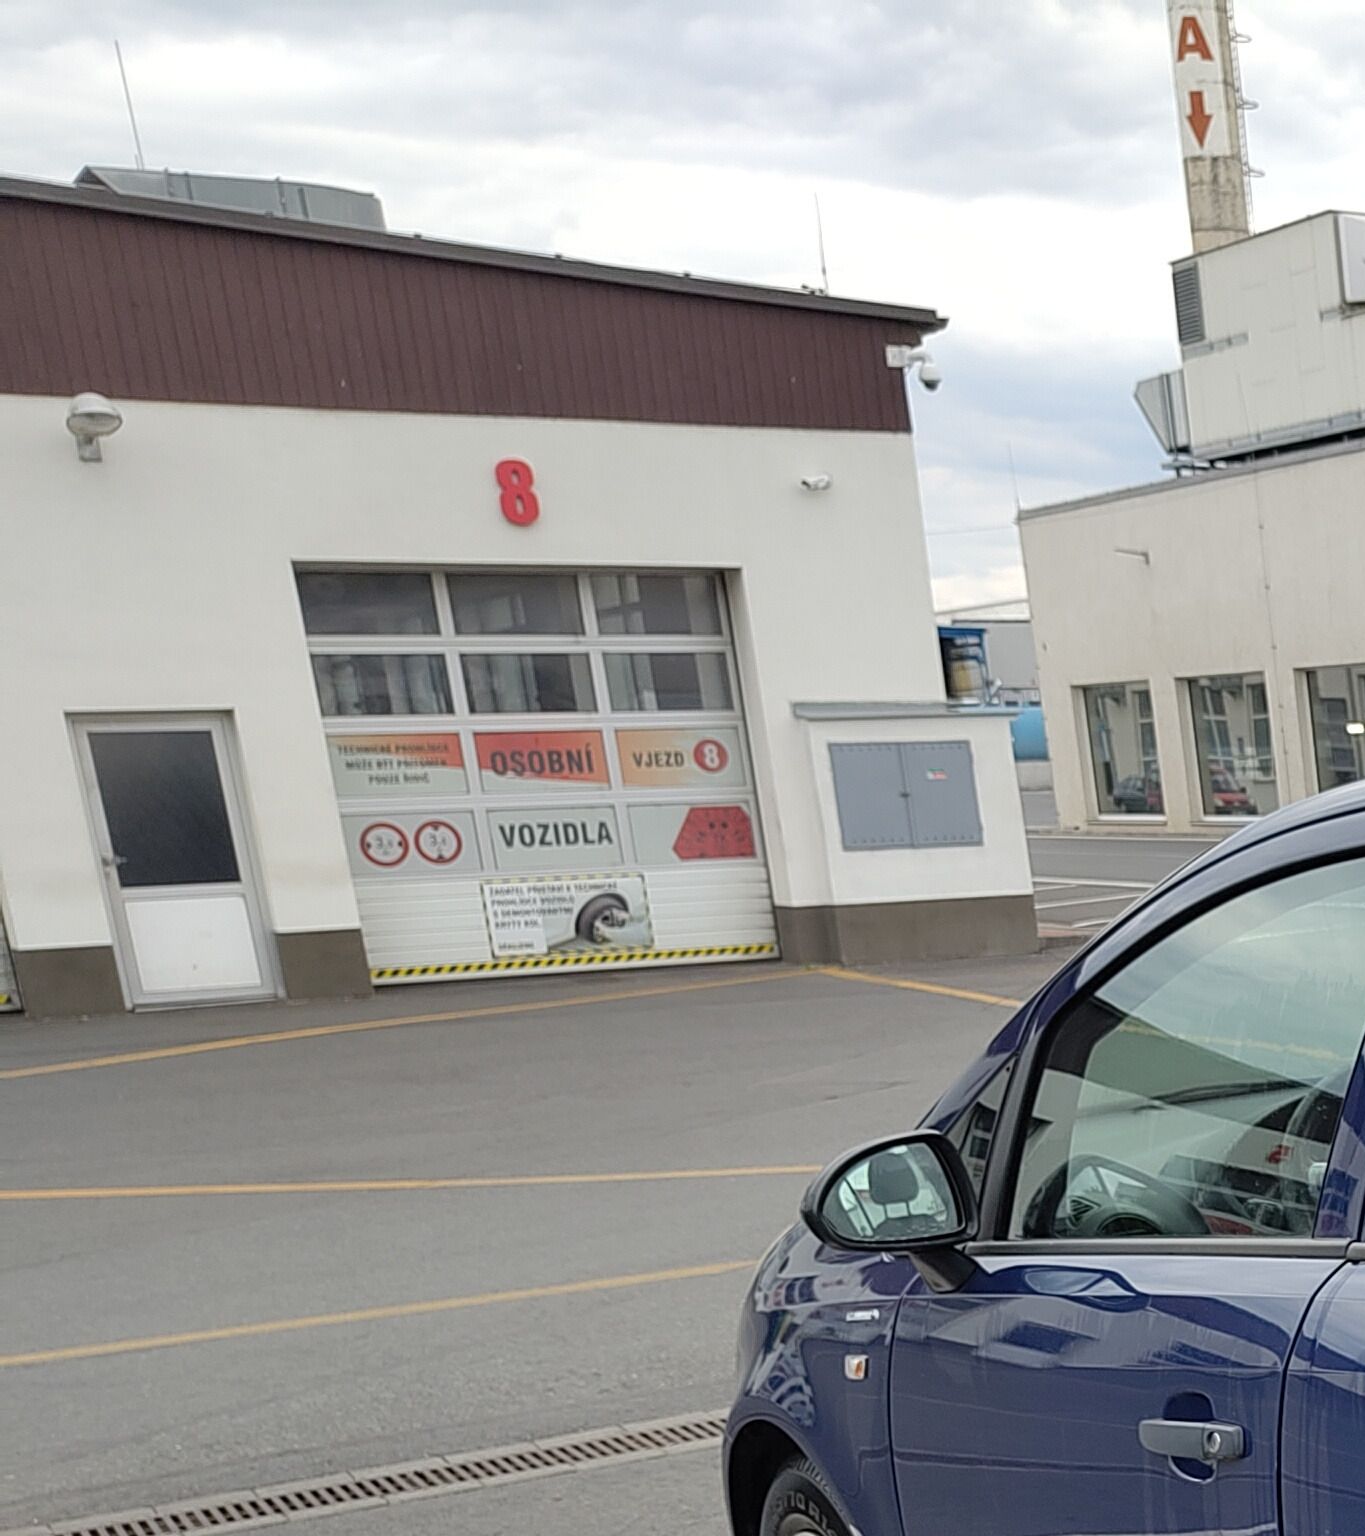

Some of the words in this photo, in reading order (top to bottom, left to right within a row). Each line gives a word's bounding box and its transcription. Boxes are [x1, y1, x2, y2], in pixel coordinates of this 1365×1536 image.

[1176, 16, 1214, 62] A
[495, 459, 539, 528] 8
[490, 743, 594, 777] OSOBNÍ
[632, 751, 685, 769] VJEZD
[499, 822, 614, 848] VOZIDLA
